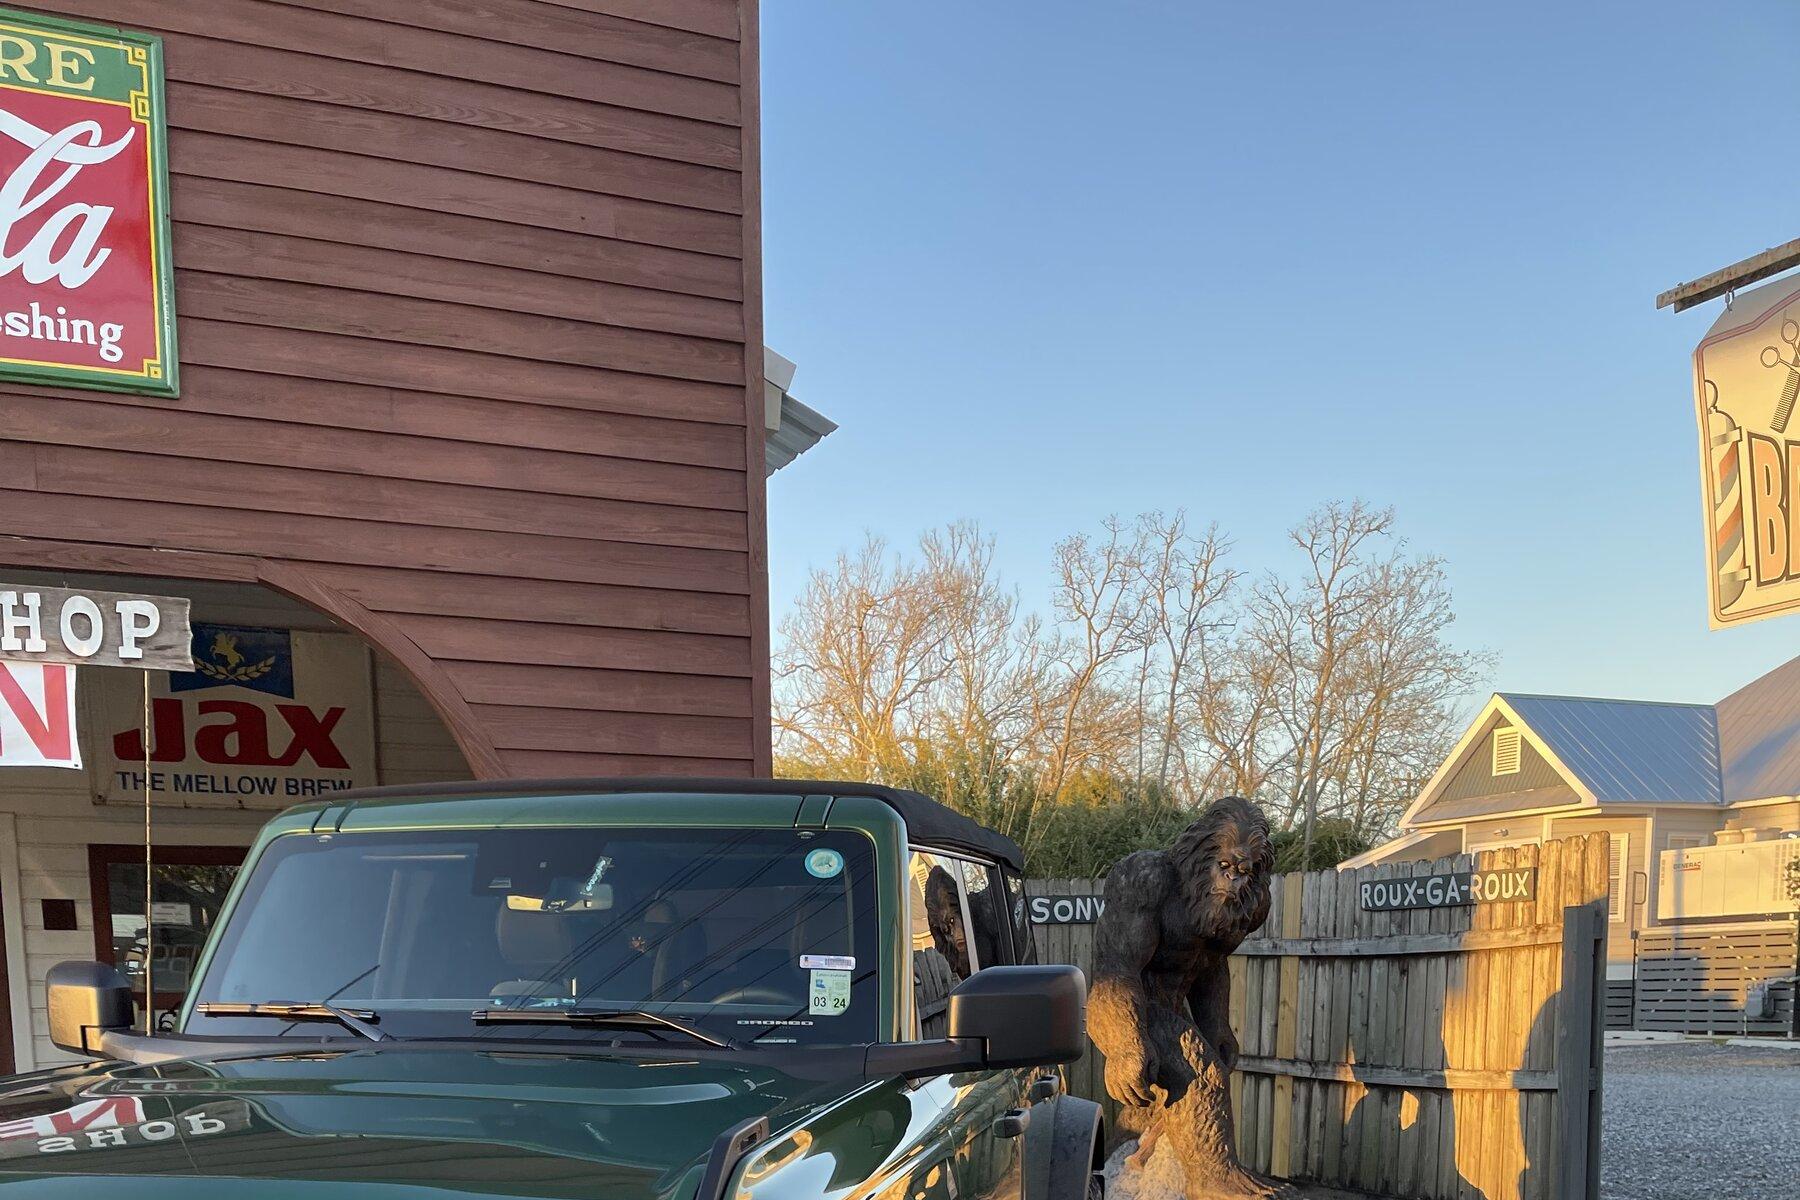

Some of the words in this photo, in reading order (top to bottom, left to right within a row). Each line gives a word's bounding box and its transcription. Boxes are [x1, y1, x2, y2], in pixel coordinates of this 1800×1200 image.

[0, 34, 96, 91] RE
[0, 302, 124, 362] shing
[0, 591, 160, 659] HOP
[116, 771, 165, 791] THE
[174, 774, 277, 795] MELLOW
[1361, 872, 1529, 909] ROUX-GA-ROUX
[813, 996, 827, 1007] 03
[833, 998, 846, 1009] 24
